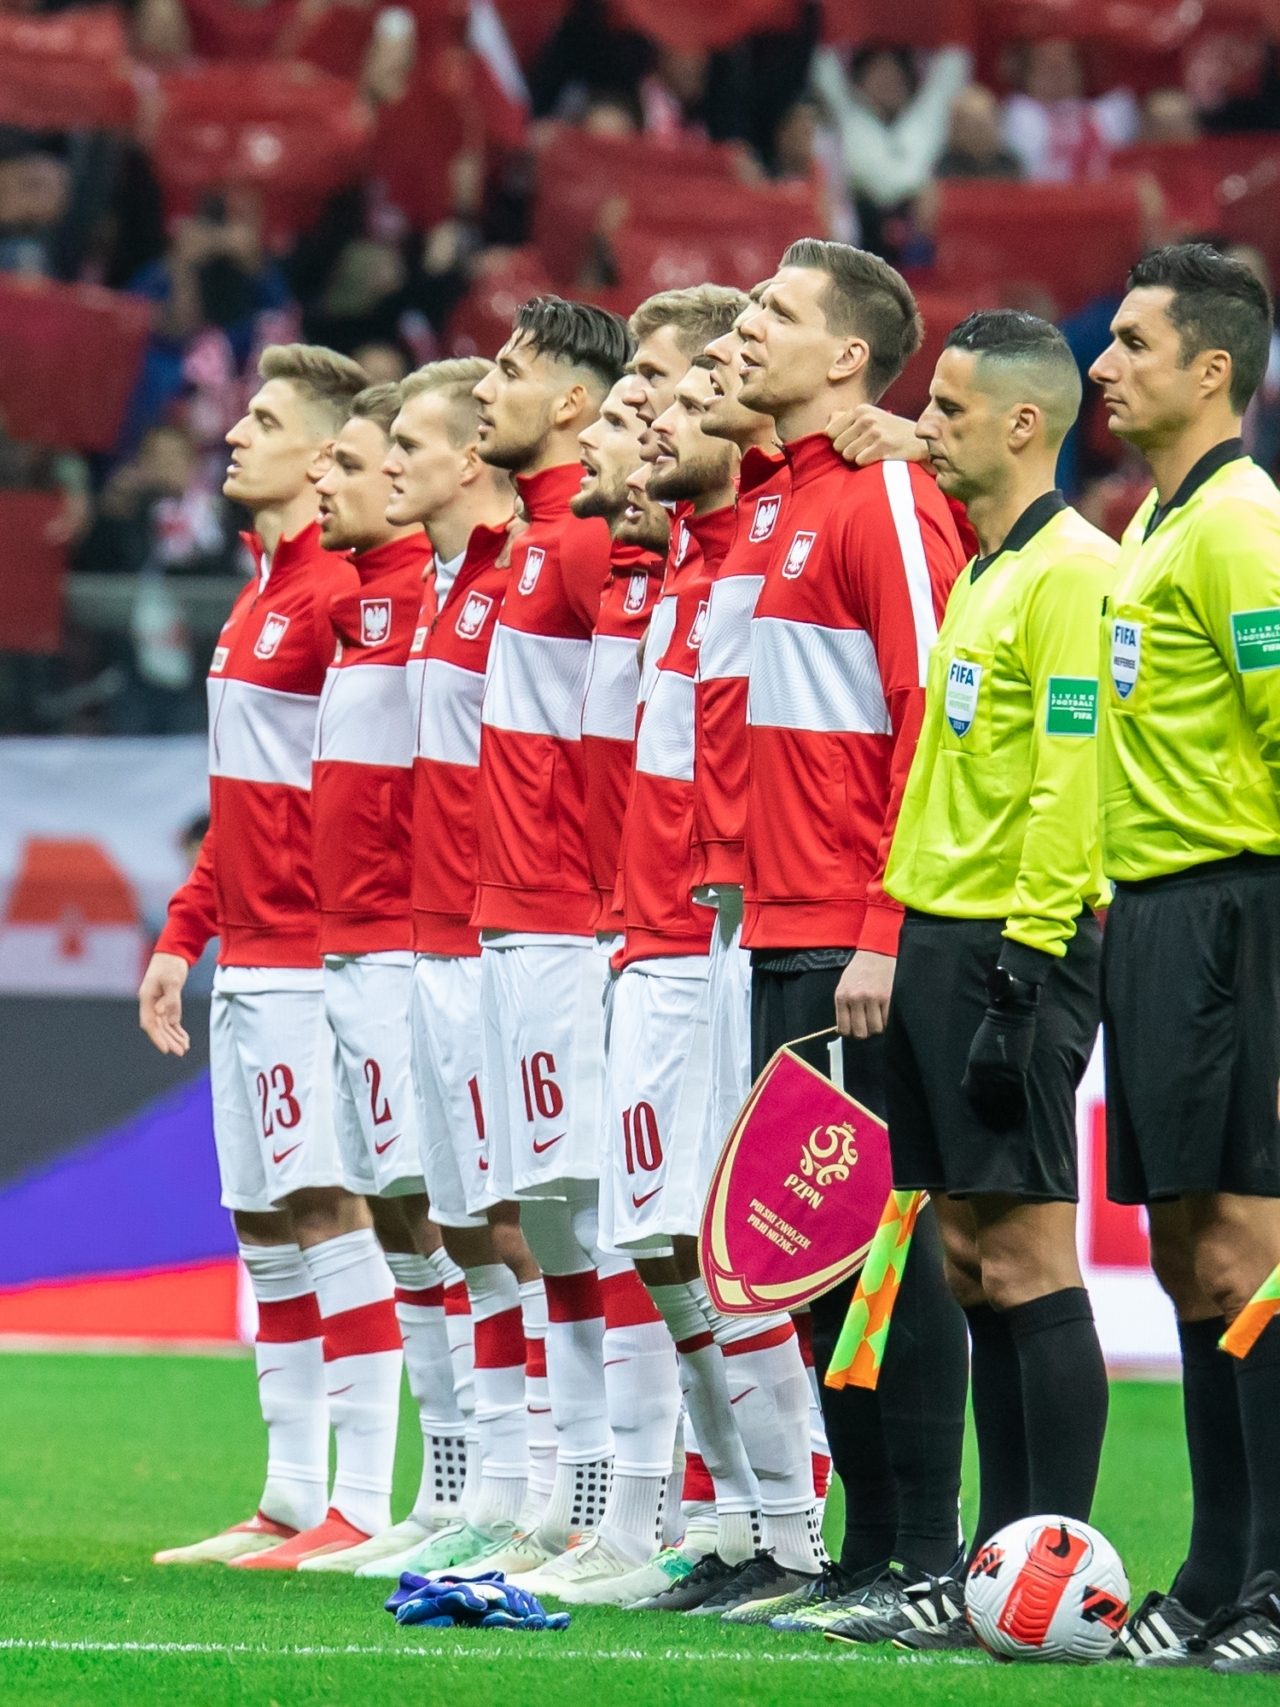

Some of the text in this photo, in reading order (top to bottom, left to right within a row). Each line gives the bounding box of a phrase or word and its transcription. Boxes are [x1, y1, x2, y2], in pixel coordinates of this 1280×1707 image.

[1115, 625, 1136, 648] FIFA
[950, 663, 974, 686] FIFA
[1051, 693, 1095, 701] LIVING
[1051, 699, 1093, 707] FOOTBALL
[1073, 711, 1093, 720] FIFA
[363, 1057, 393, 1126] 2
[520, 1050, 565, 1123] 16
[256, 1062, 302, 1140] 23
[621, 1100, 664, 1176] 10
[783, 1173, 824, 1210] PZPN
[748, 1198, 778, 1224] POLSKI
